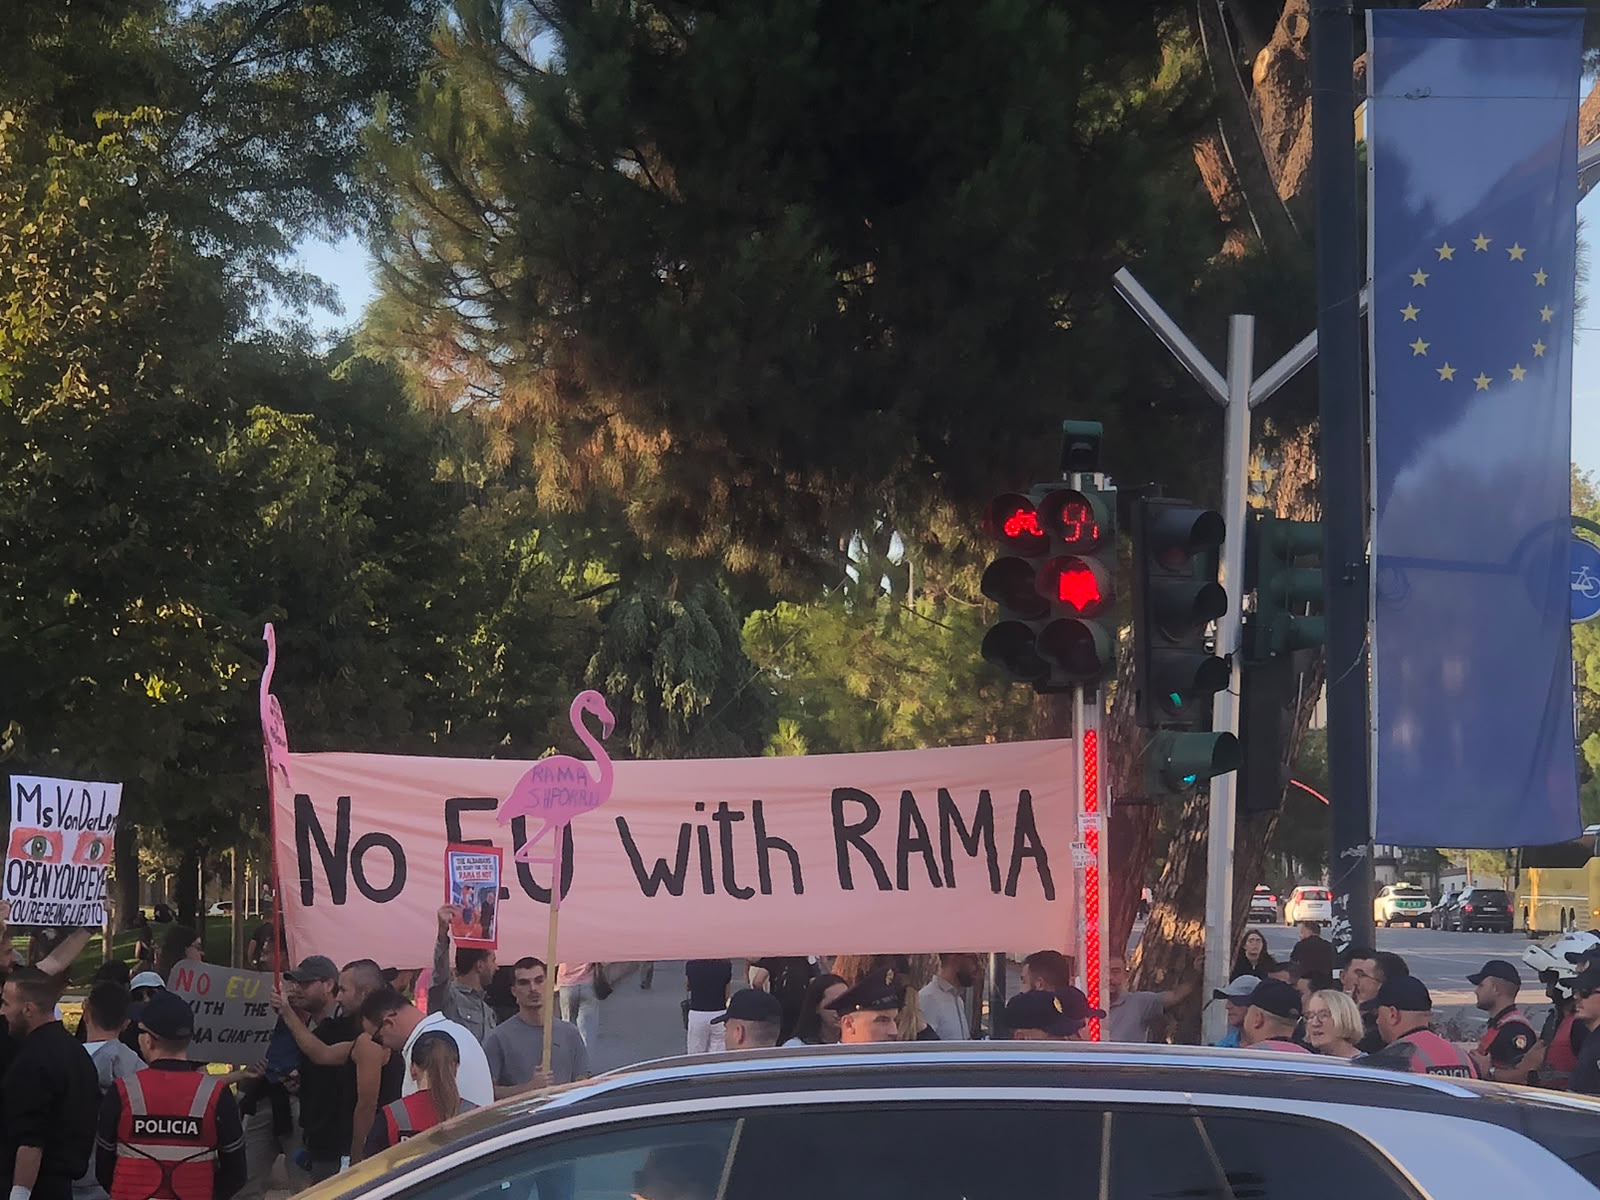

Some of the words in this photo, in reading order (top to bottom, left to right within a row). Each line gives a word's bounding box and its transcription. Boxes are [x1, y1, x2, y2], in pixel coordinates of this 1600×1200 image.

[532, 765, 588, 786] RAMA
[16, 782, 55, 828] Ms
[294, 793, 407, 906] No
[831, 787, 1056, 901] RAMA
[175, 967, 212, 996] NO
[225, 976, 260, 999] EU
[243, 1002, 270, 1017] THE
[218, 1028, 274, 1044] CHAPTE
[135, 1119, 199, 1135] POLICIA
